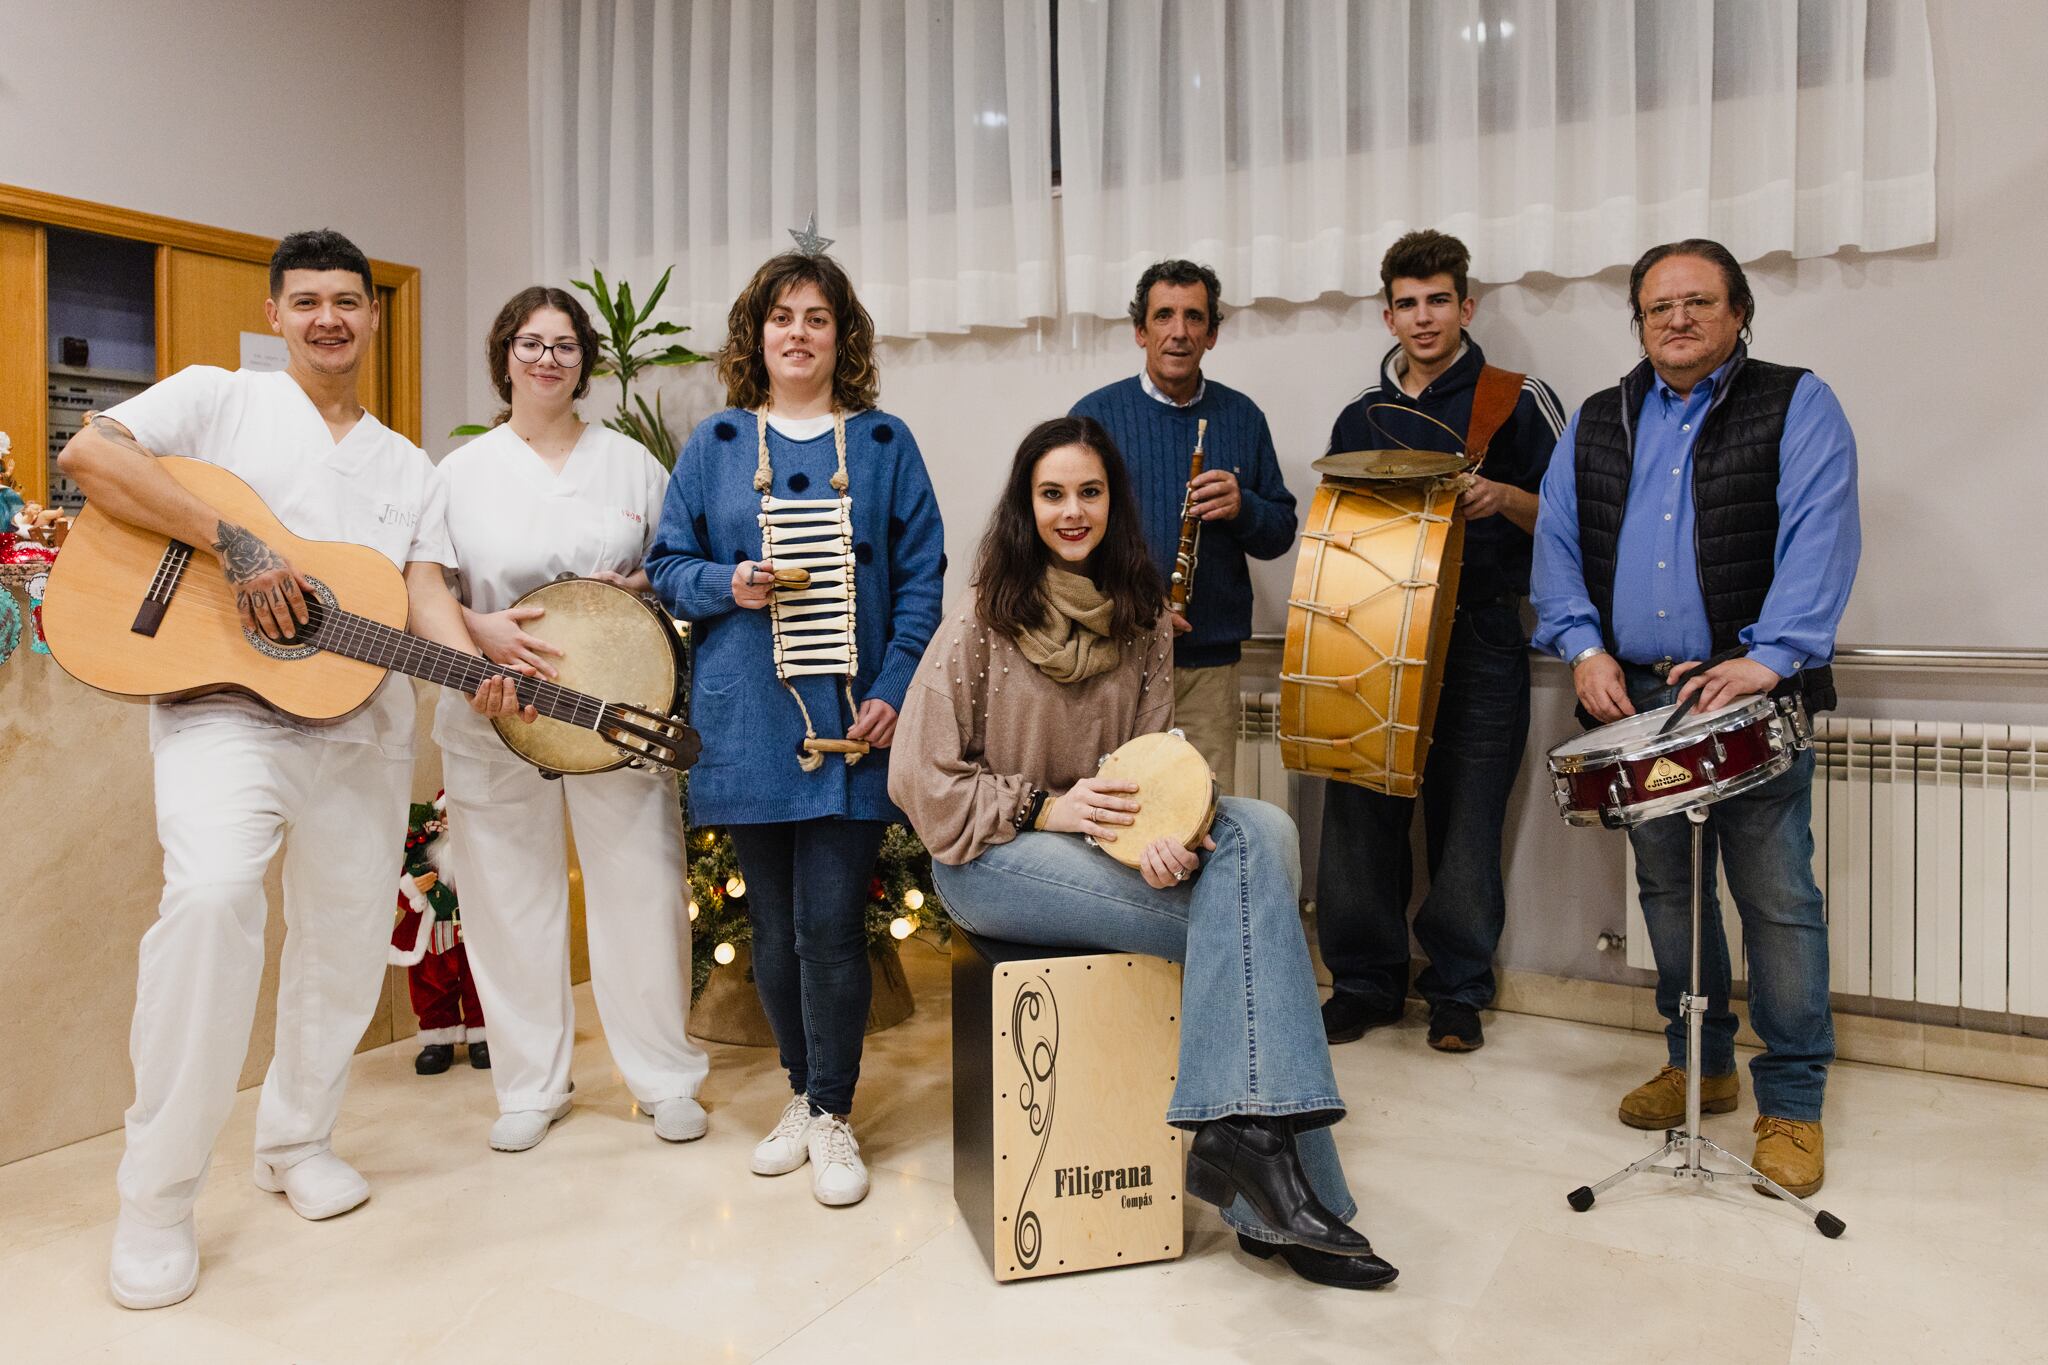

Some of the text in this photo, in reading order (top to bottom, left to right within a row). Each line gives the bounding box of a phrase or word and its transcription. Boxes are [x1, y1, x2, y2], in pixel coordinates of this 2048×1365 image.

[1651, 773, 1686, 788] JINBAO
[1054, 1165, 1153, 1199] Filigrana
[1121, 1193, 1153, 1209] Compás
